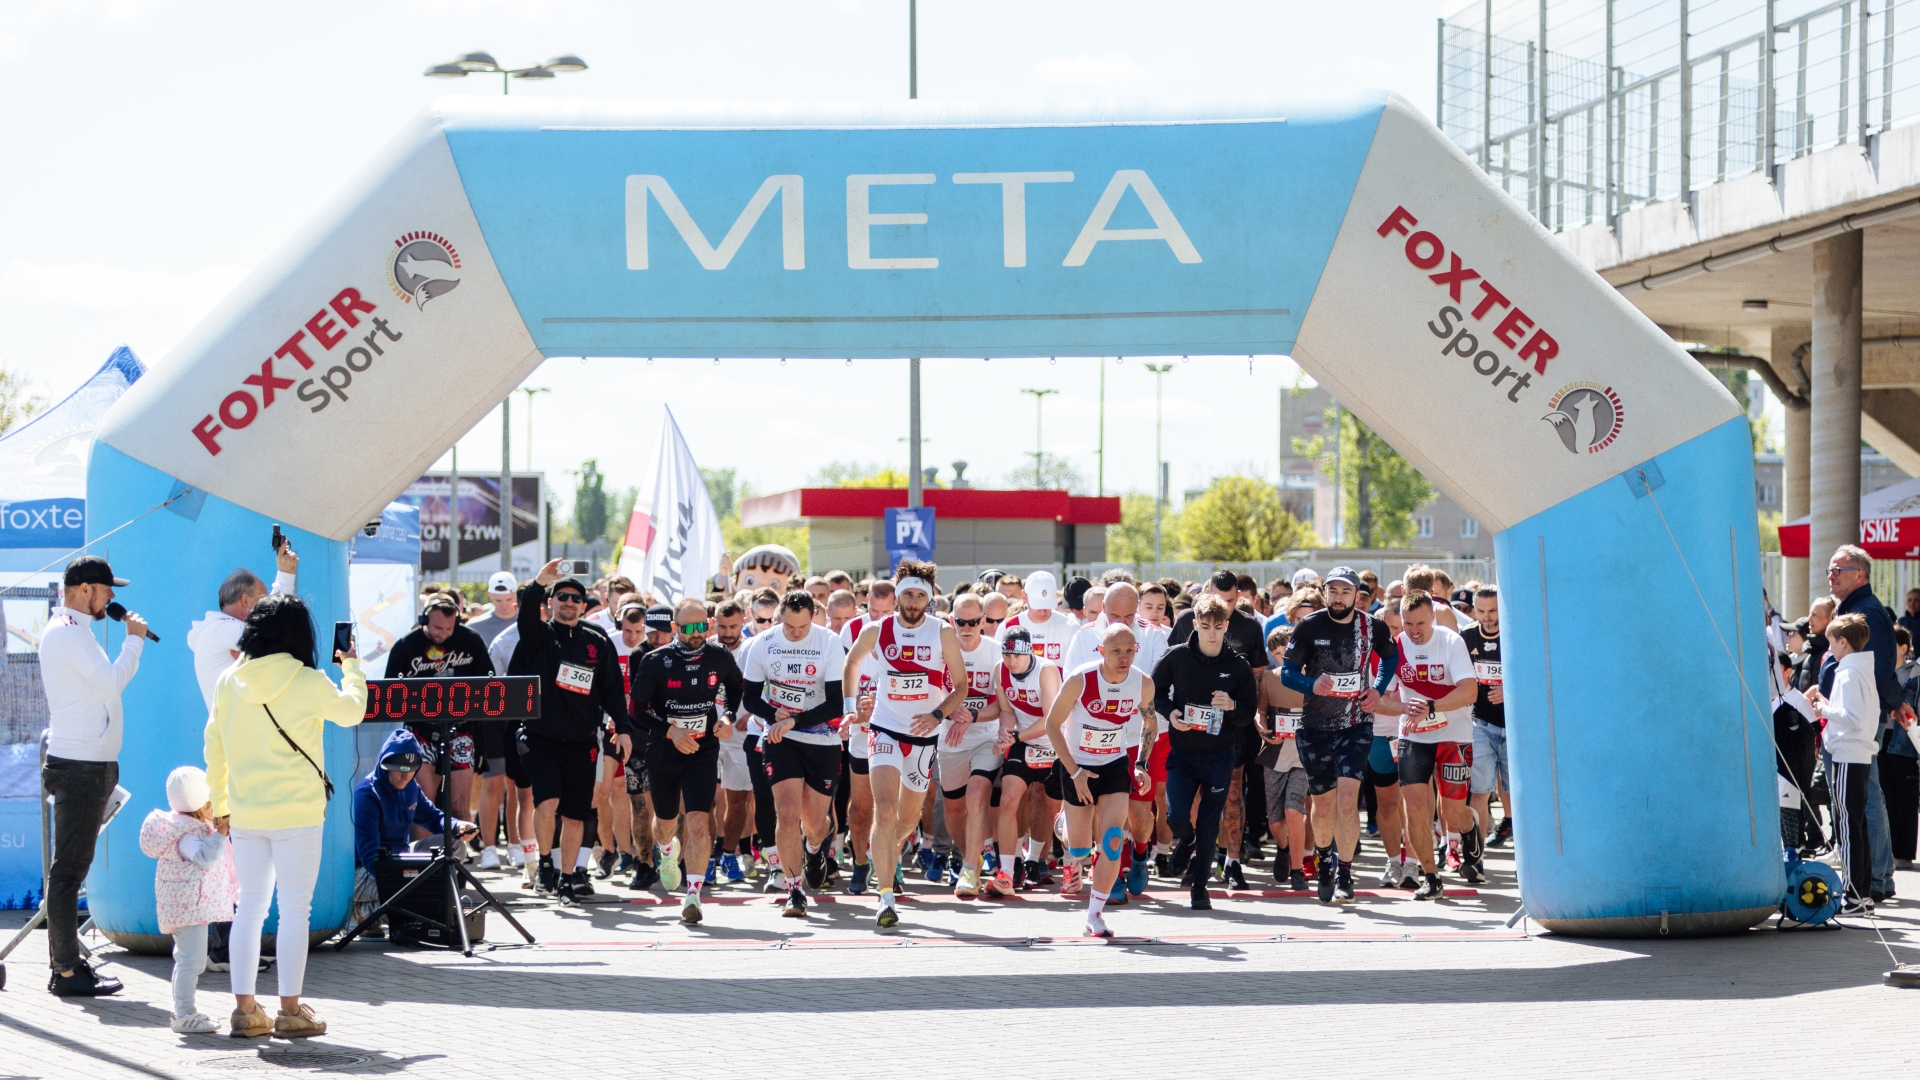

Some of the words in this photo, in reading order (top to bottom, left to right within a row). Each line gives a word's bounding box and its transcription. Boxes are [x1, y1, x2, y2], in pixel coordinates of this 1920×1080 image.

[625, 169, 1203, 270] META
[1376, 205, 1559, 376] FOXTER
[1427, 305, 1532, 404] Sport
[297, 316, 403, 413] Sport
[191, 287, 378, 457] FOXTER
[0, 503, 83, 529] foxte
[896, 520, 923, 544] P7
[787, 663, 801, 674] MST
[571, 670, 591, 683] 360
[1337, 677, 1356, 687] 124
[902, 679, 923, 689] 312
[780, 690, 802, 703] 366
[1200, 710, 1212, 720] 15
[682, 720, 704, 730] 372
[1100, 733, 1117, 743] 27
[1035, 749, 1056, 758] 249
[1, 833, 25, 848] su
